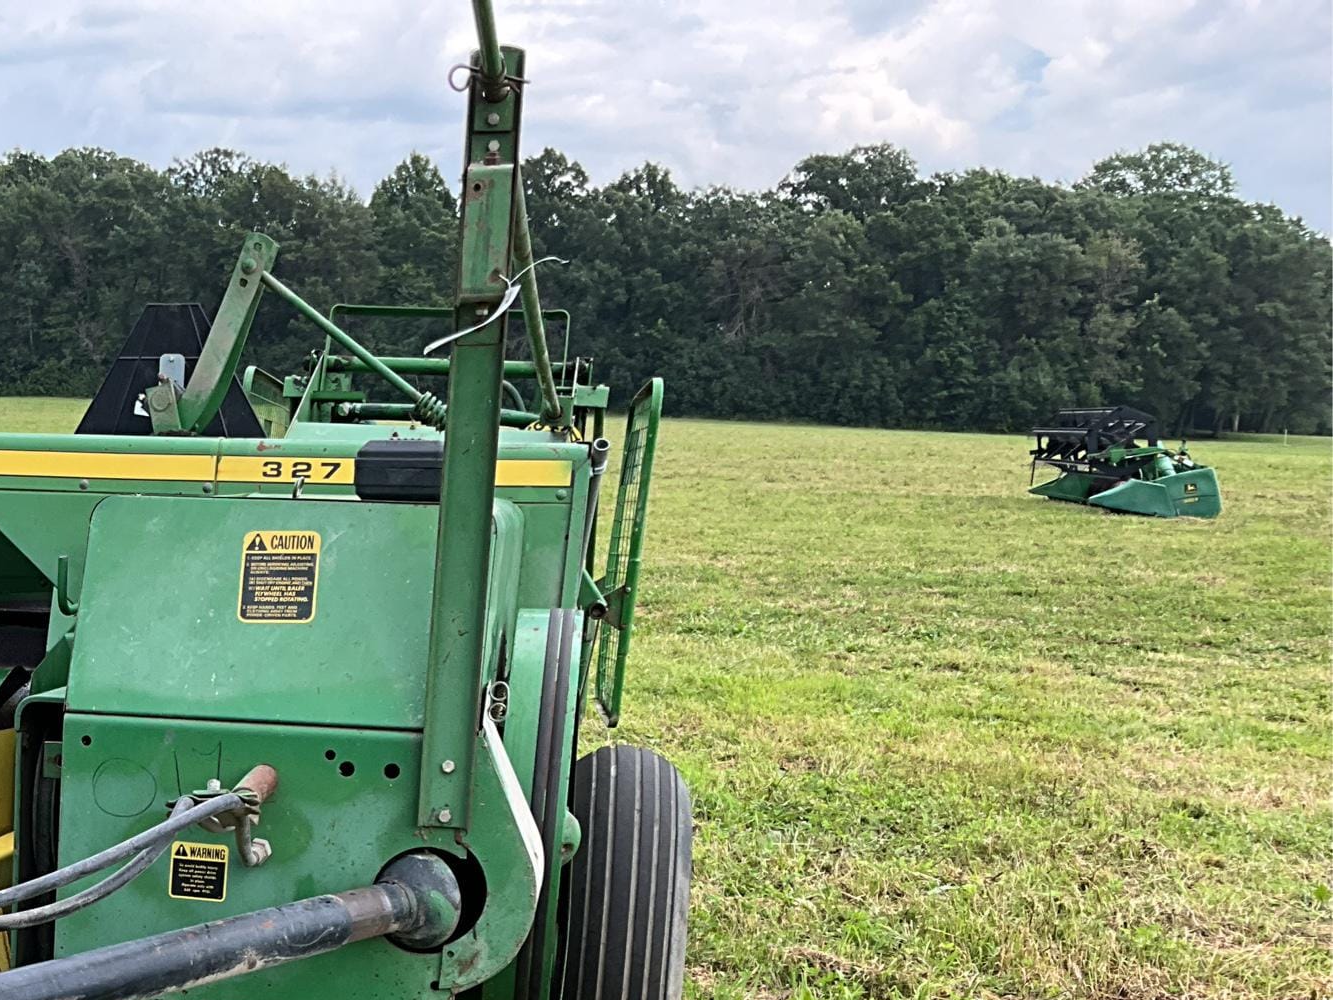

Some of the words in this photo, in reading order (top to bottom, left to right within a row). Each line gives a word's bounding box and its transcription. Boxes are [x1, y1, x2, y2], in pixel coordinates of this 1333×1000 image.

[262, 461, 341, 479] 327
[271, 535, 315, 550] CAUTION
[190, 846, 226, 860] WARNING
